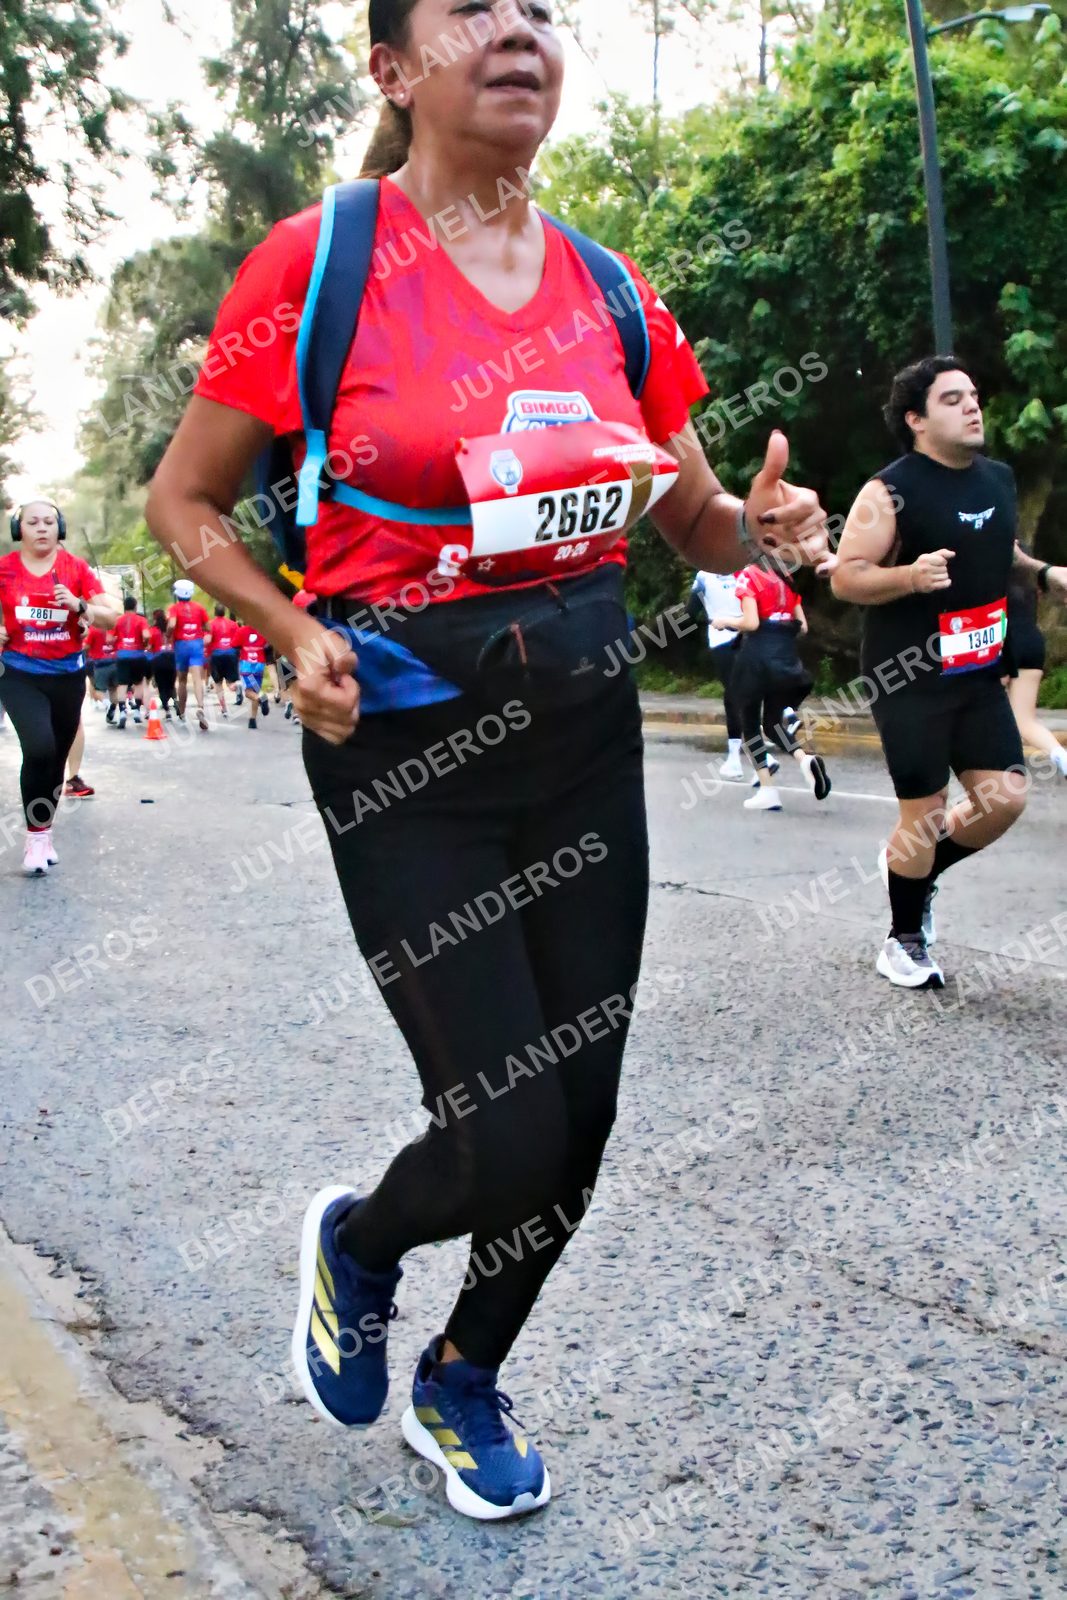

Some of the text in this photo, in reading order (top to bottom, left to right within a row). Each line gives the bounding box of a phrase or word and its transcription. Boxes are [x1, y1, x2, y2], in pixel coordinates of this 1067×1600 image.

[520, 402, 582, 415] BIMBO
[534, 485, 623, 542] 2662
[30, 608, 53, 620] 2861
[968, 627, 995, 649] 1340
